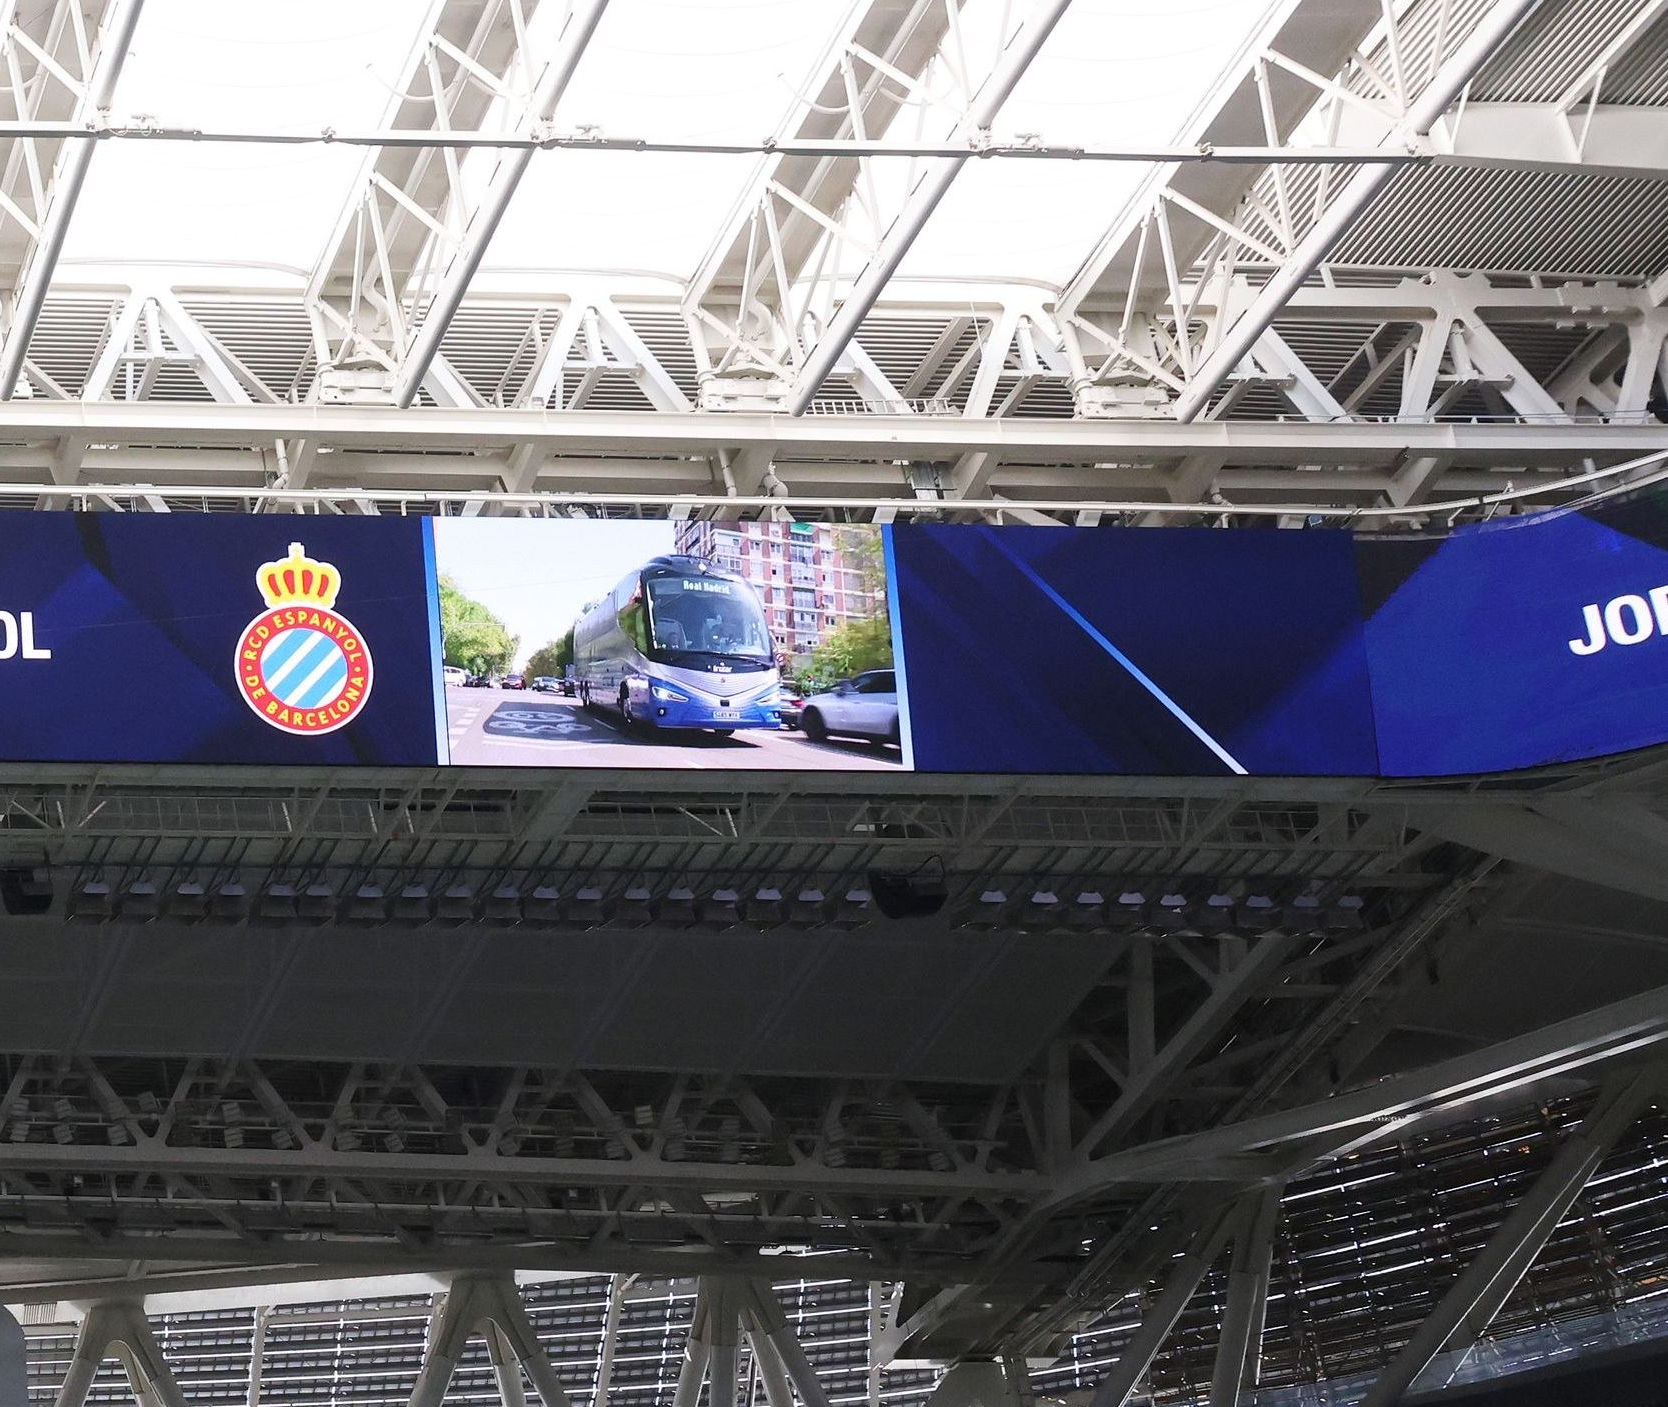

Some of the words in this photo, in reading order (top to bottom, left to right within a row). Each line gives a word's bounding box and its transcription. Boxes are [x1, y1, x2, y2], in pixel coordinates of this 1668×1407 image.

[243, 624, 270, 661] RCD
[272, 610, 363, 663] ESPANYOL
[245, 674, 267, 700] DE
[265, 675, 365, 727] BARCELONA
